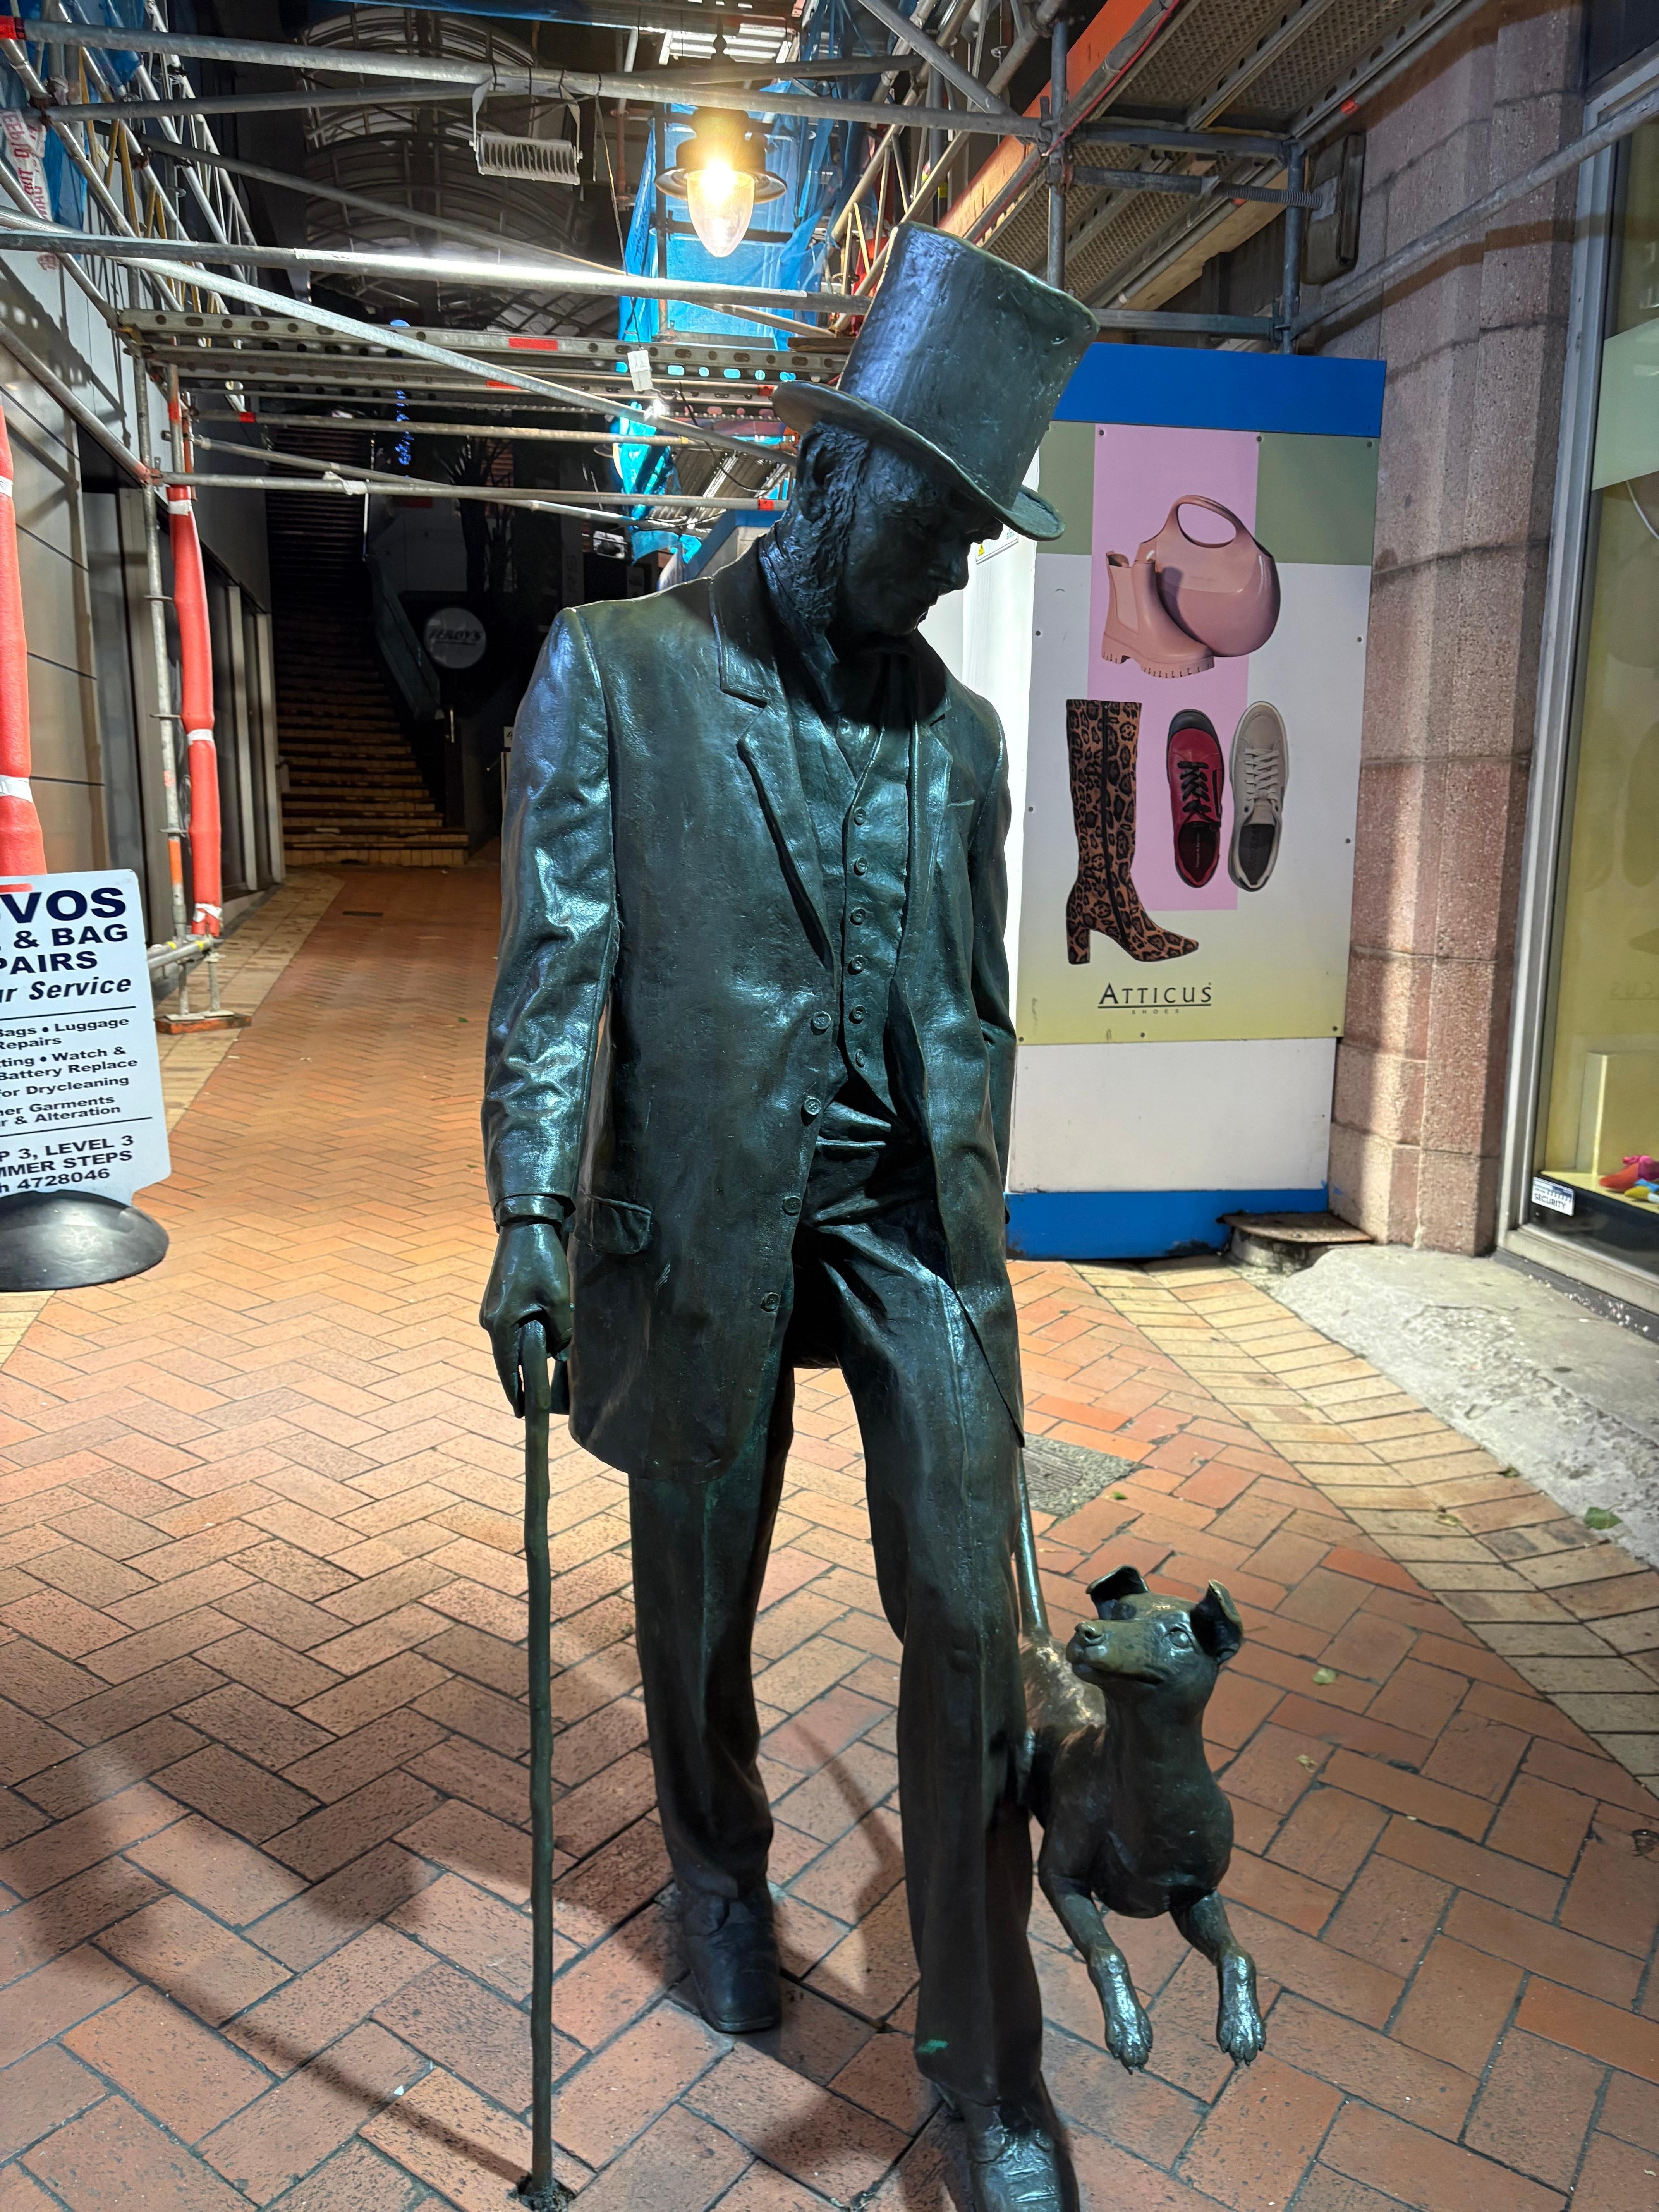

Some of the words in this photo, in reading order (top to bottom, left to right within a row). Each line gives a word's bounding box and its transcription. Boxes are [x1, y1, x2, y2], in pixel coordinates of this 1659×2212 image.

[0, 887, 126, 923] VOS
[14, 930, 40, 949] &
[52, 924, 128, 946] BAG
[29, 977, 131, 1000] Service
[1099, 982, 1211, 1004] ATTICUS
[54, 1018, 129, 1032] Luggage
[0, 1058, 34, 1068] ting
[52, 1049, 107, 1061] Watch
[113, 1046, 126, 1055] &
[0, 1068, 62, 1081] Battery
[68, 1060, 137, 1073] Replace
[0, 1089, 20, 1098] or
[26, 1077, 129, 1094] Drycleaning
[29, 1096, 115, 1112] Garments
[14, 1116, 28, 1125] &
[34, 1106, 121, 1122] Alteration
[18, 1148, 38, 1160] 3,
[45, 1139, 115, 1156] LEVEL
[121, 1135, 134, 1146] 3
[63, 1151, 132, 1168] STEPS
[17, 1168, 110, 1189] 4728046
[1534, 1193, 1566, 1209] SECURITY
